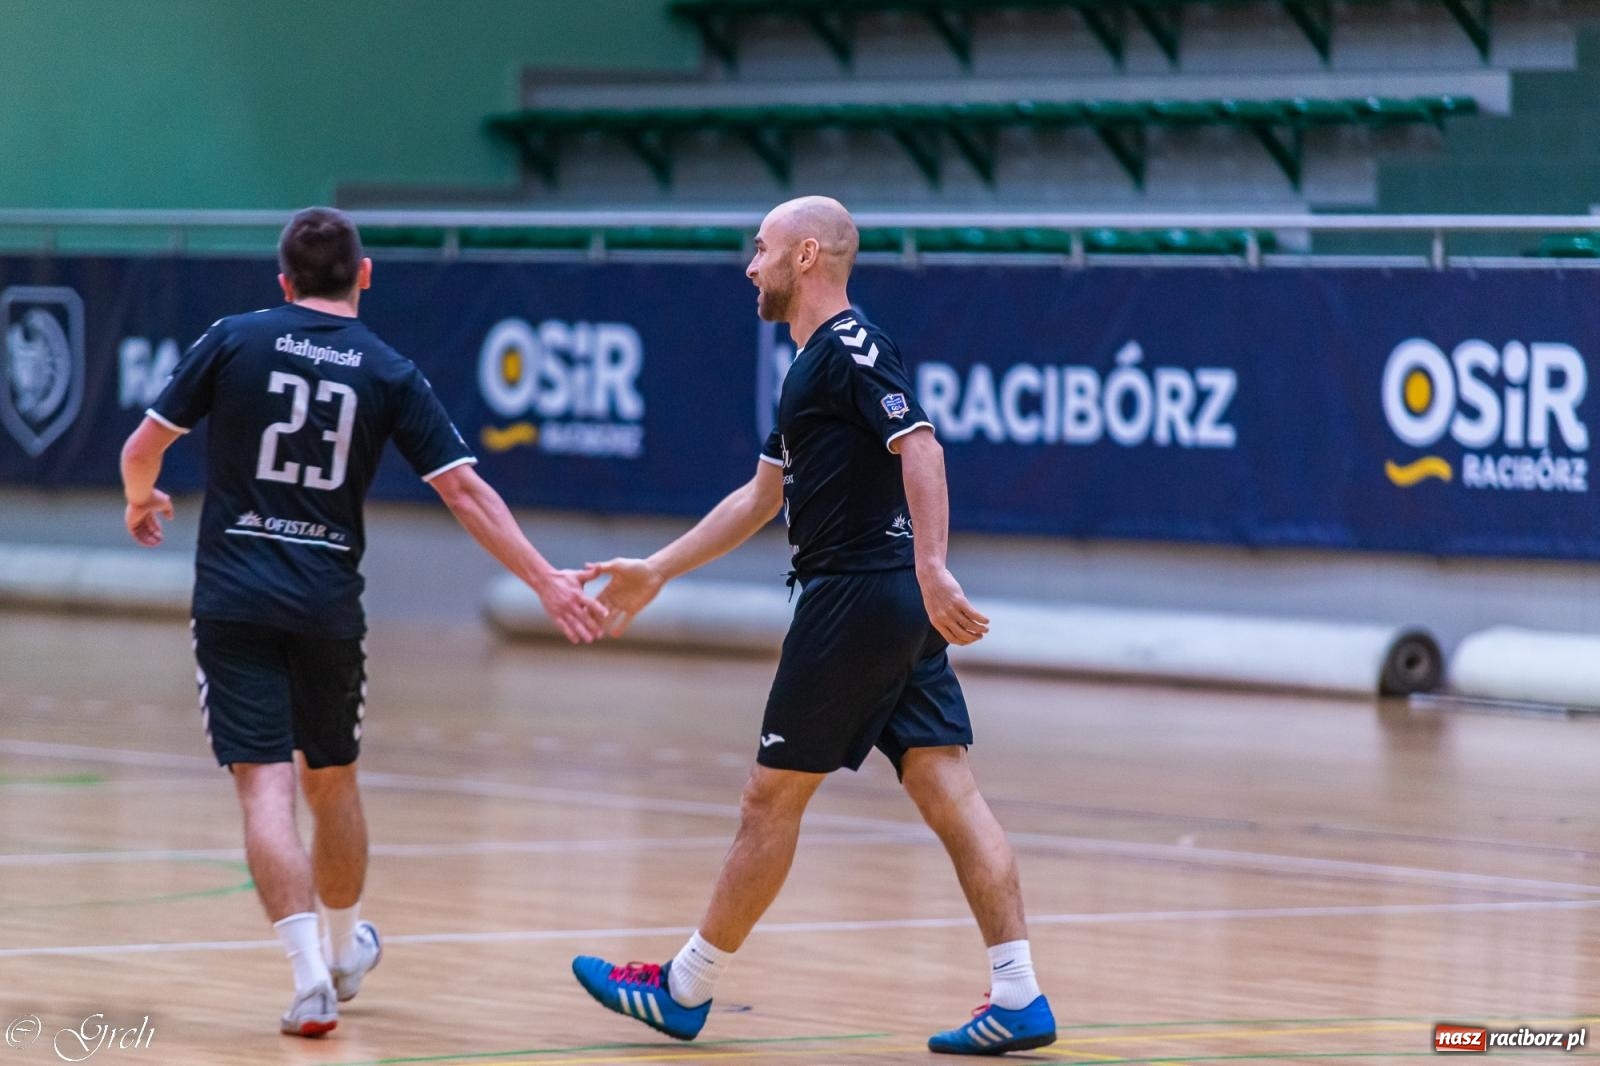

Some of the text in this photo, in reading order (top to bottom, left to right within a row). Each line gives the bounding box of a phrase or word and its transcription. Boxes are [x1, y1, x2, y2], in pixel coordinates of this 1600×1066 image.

[255, 370, 358, 491] 23
[918, 341, 1237, 448] RACIBÓRZ
[1382, 338, 1589, 452] OSiR
[1462, 449, 1588, 492] RACIBÓRZ
[264, 517, 326, 537] OFISTAR
